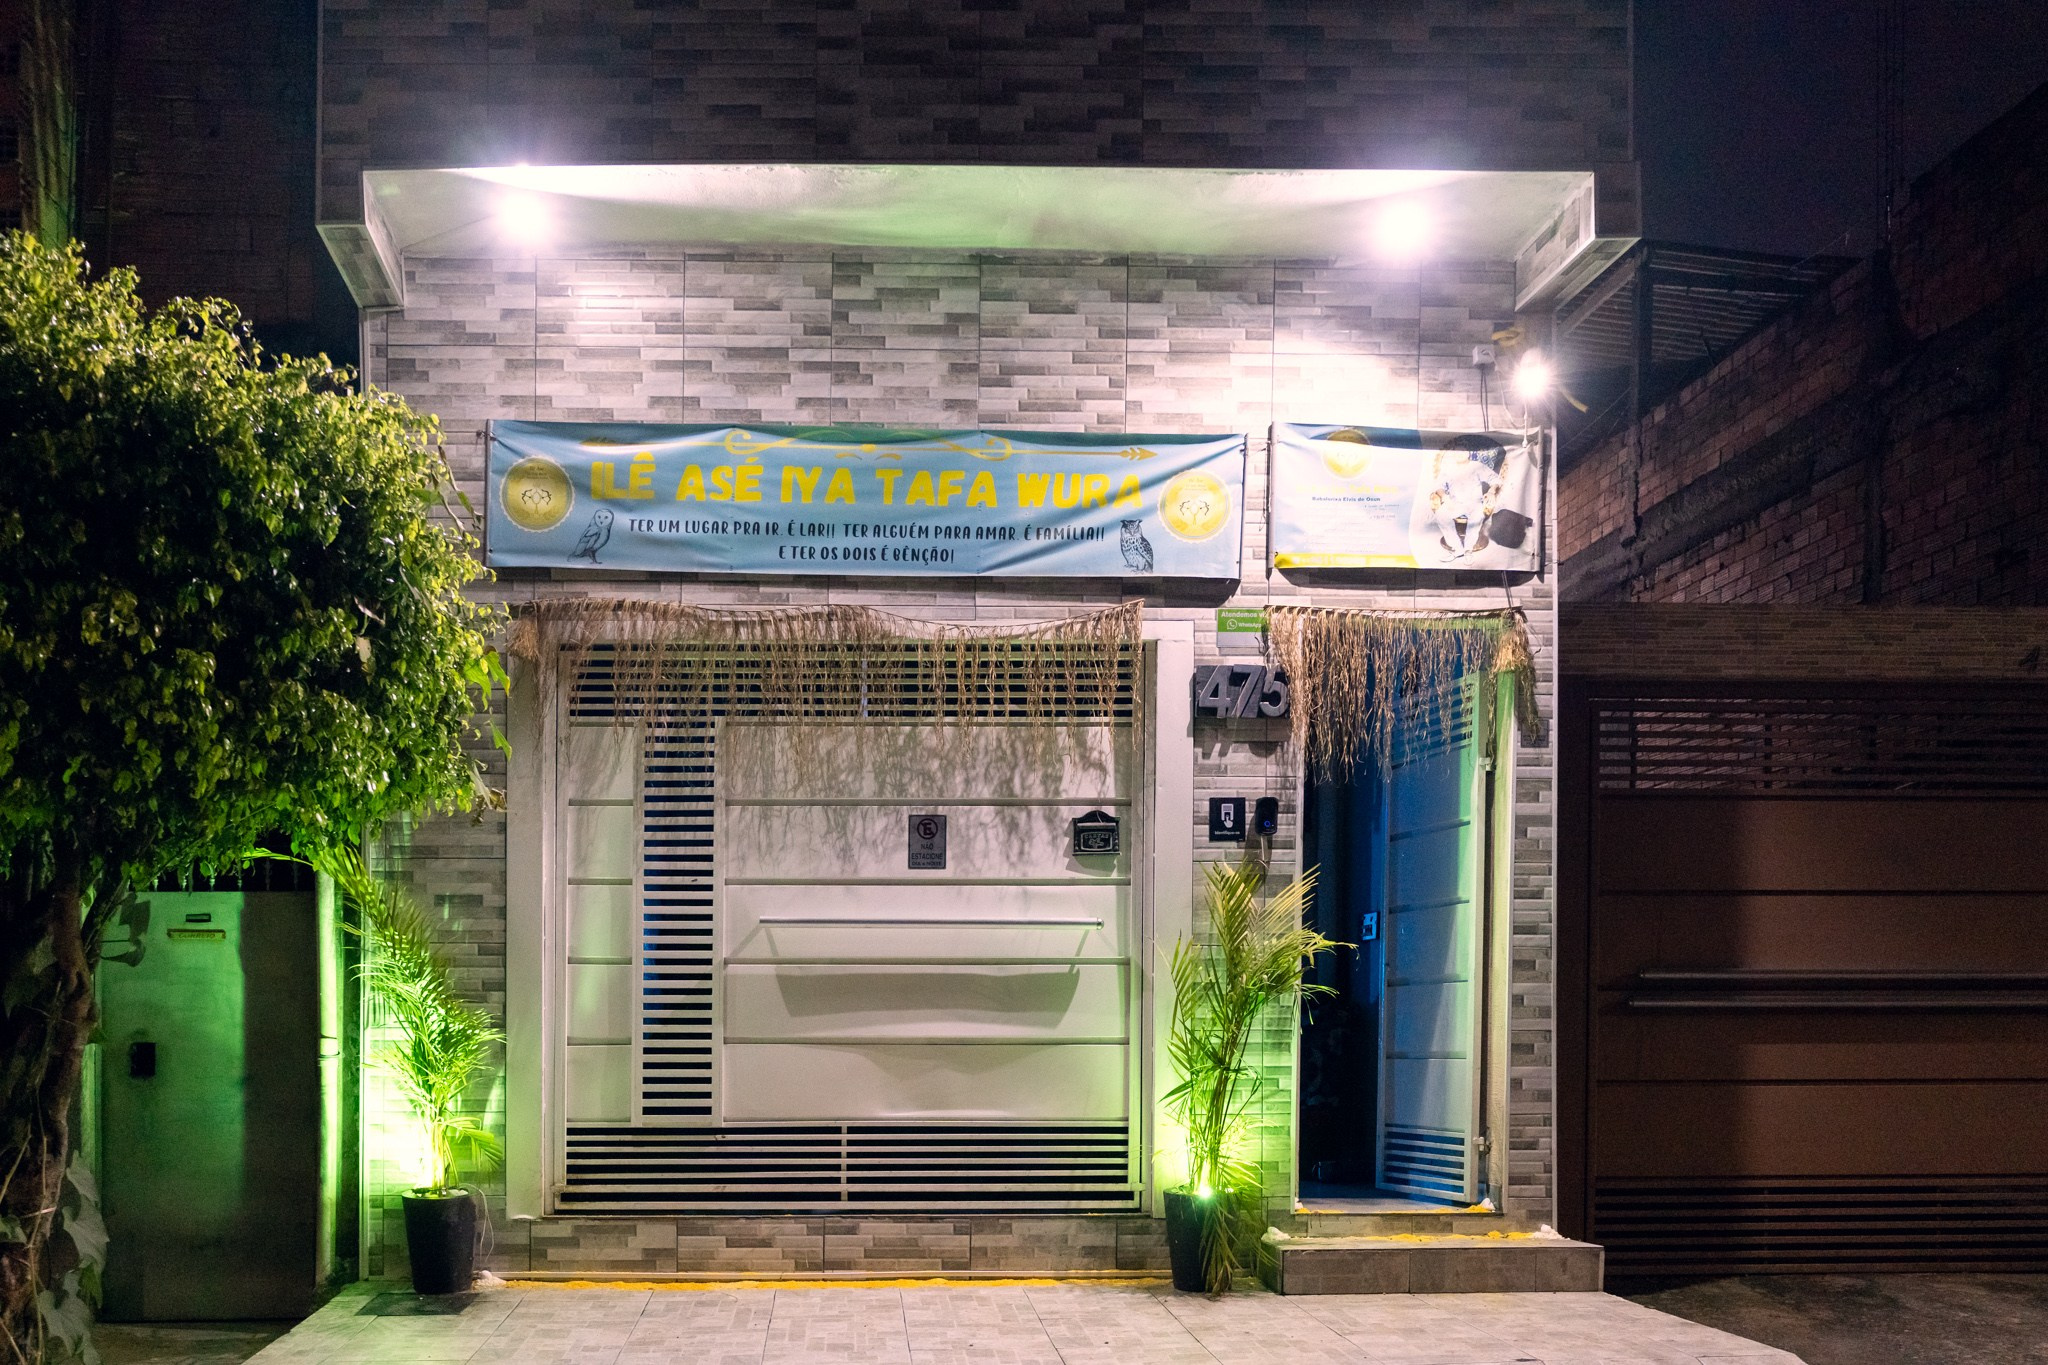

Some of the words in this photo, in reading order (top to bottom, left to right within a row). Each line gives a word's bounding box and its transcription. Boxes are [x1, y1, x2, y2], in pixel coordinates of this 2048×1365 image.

[591, 451, 656, 499] ILÊ
[676, 457, 764, 502] ASÉ
[781, 466, 856, 504] IYA
[876, 469, 997, 507] TAFA
[1017, 472, 1143, 508] WURA
[629, 519, 654, 533] TER
[658, 519, 680, 533] UM
[685, 520, 729, 535] LUGAR
[733, 521, 761, 536] PRA
[765, 522, 783, 536] IR.
[788, 519, 796, 537] É
[800, 522, 835, 538] LAR!!
[843, 523, 868, 538] TER
[873, 522, 929, 539] ALGUÉM
[934, 525, 971, 540] PARA
[975, 526, 1020, 541] AMAR.
[1024, 524, 1032, 541] É
[1036, 525, 1105, 542] FAMÍLIA!!
[779, 545, 787, 560] E
[791, 545, 816, 560] TER
[820, 546, 838, 561] OS
[842, 546, 877, 561] DOIS
[881, 545, 889, 561] É
[893, 545, 954, 566] BÊNÇÃO!
[1199, 664, 1288, 718] 475
[911, 852, 944, 860] ESTACIONE
